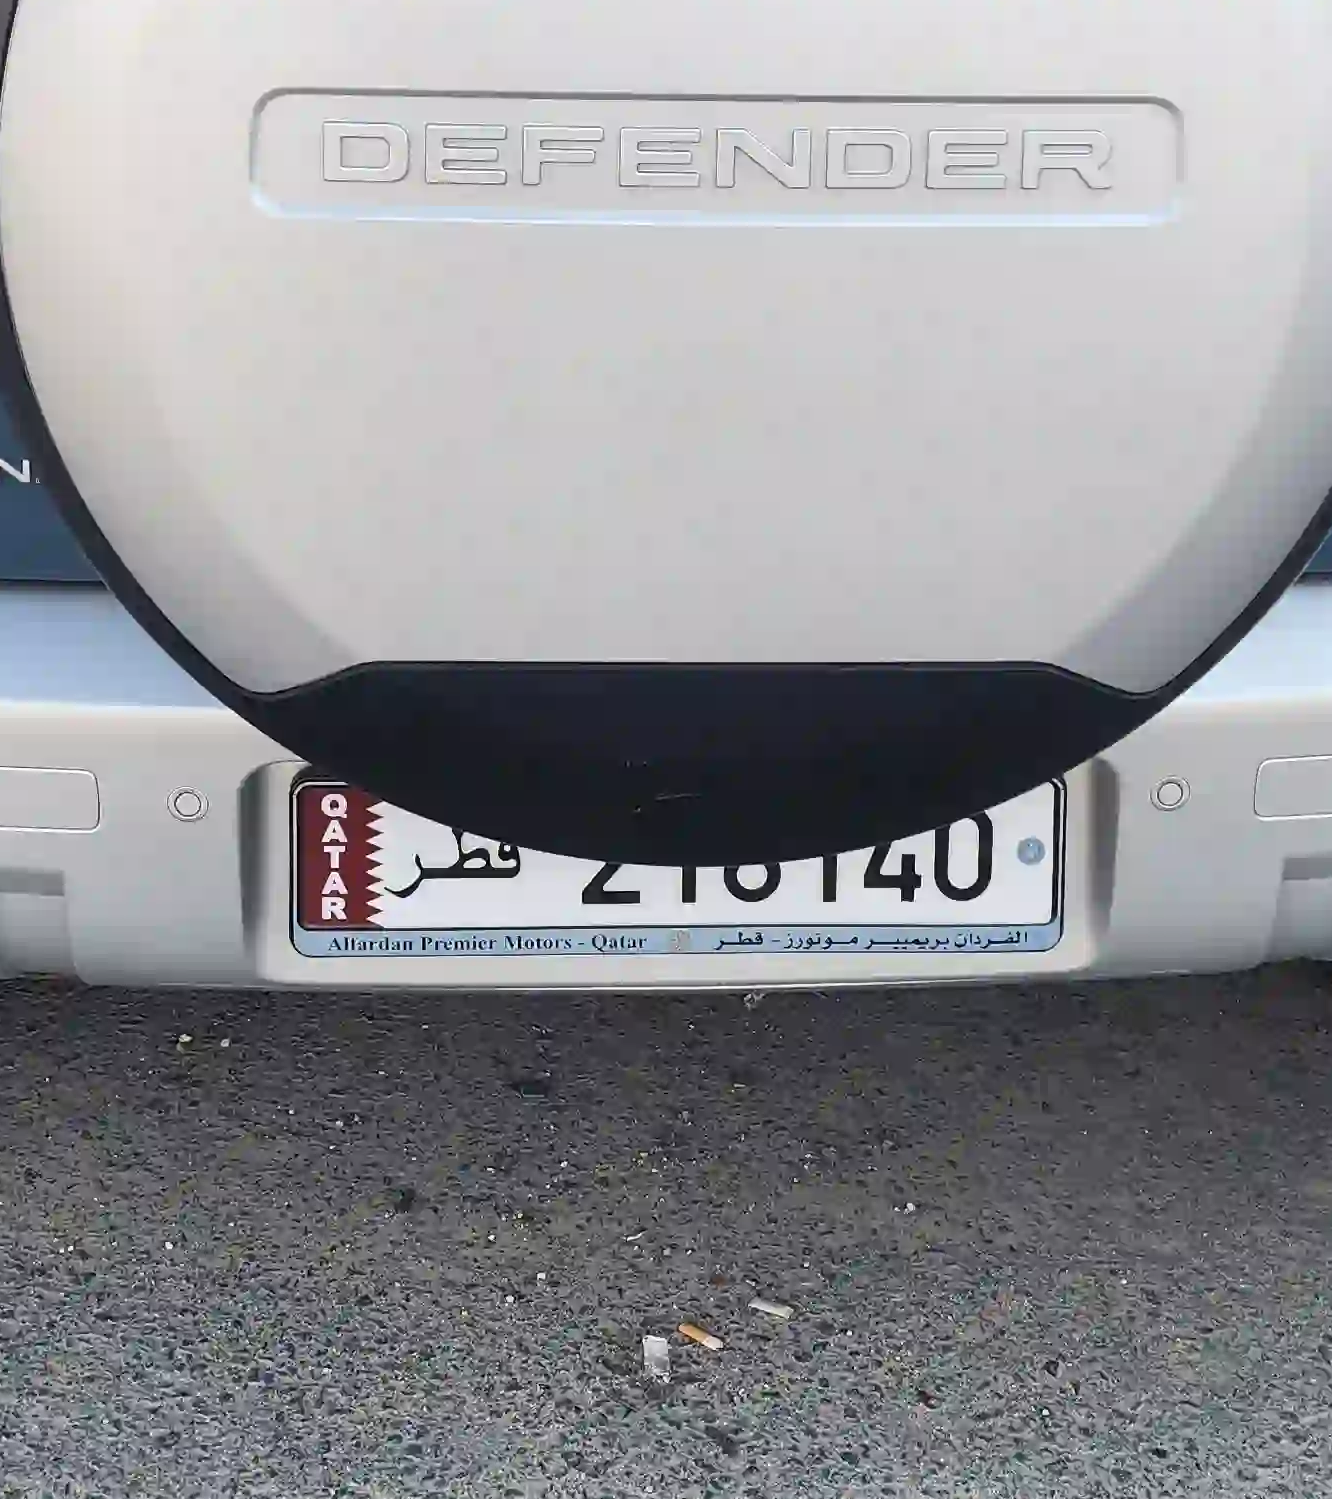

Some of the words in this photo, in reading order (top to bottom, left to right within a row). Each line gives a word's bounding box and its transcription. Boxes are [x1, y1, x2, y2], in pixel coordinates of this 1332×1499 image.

[320, 118, 1116, 193] DEFENDER
[320, 792, 349, 921] QATAR
[328, 936, 414, 952] Alfardan
[420, 936, 498, 951] Premier
[504, 935, 573, 951] Motors
[590, 933, 648, 953] Qatar
[713, 931, 764, 951] قطر
